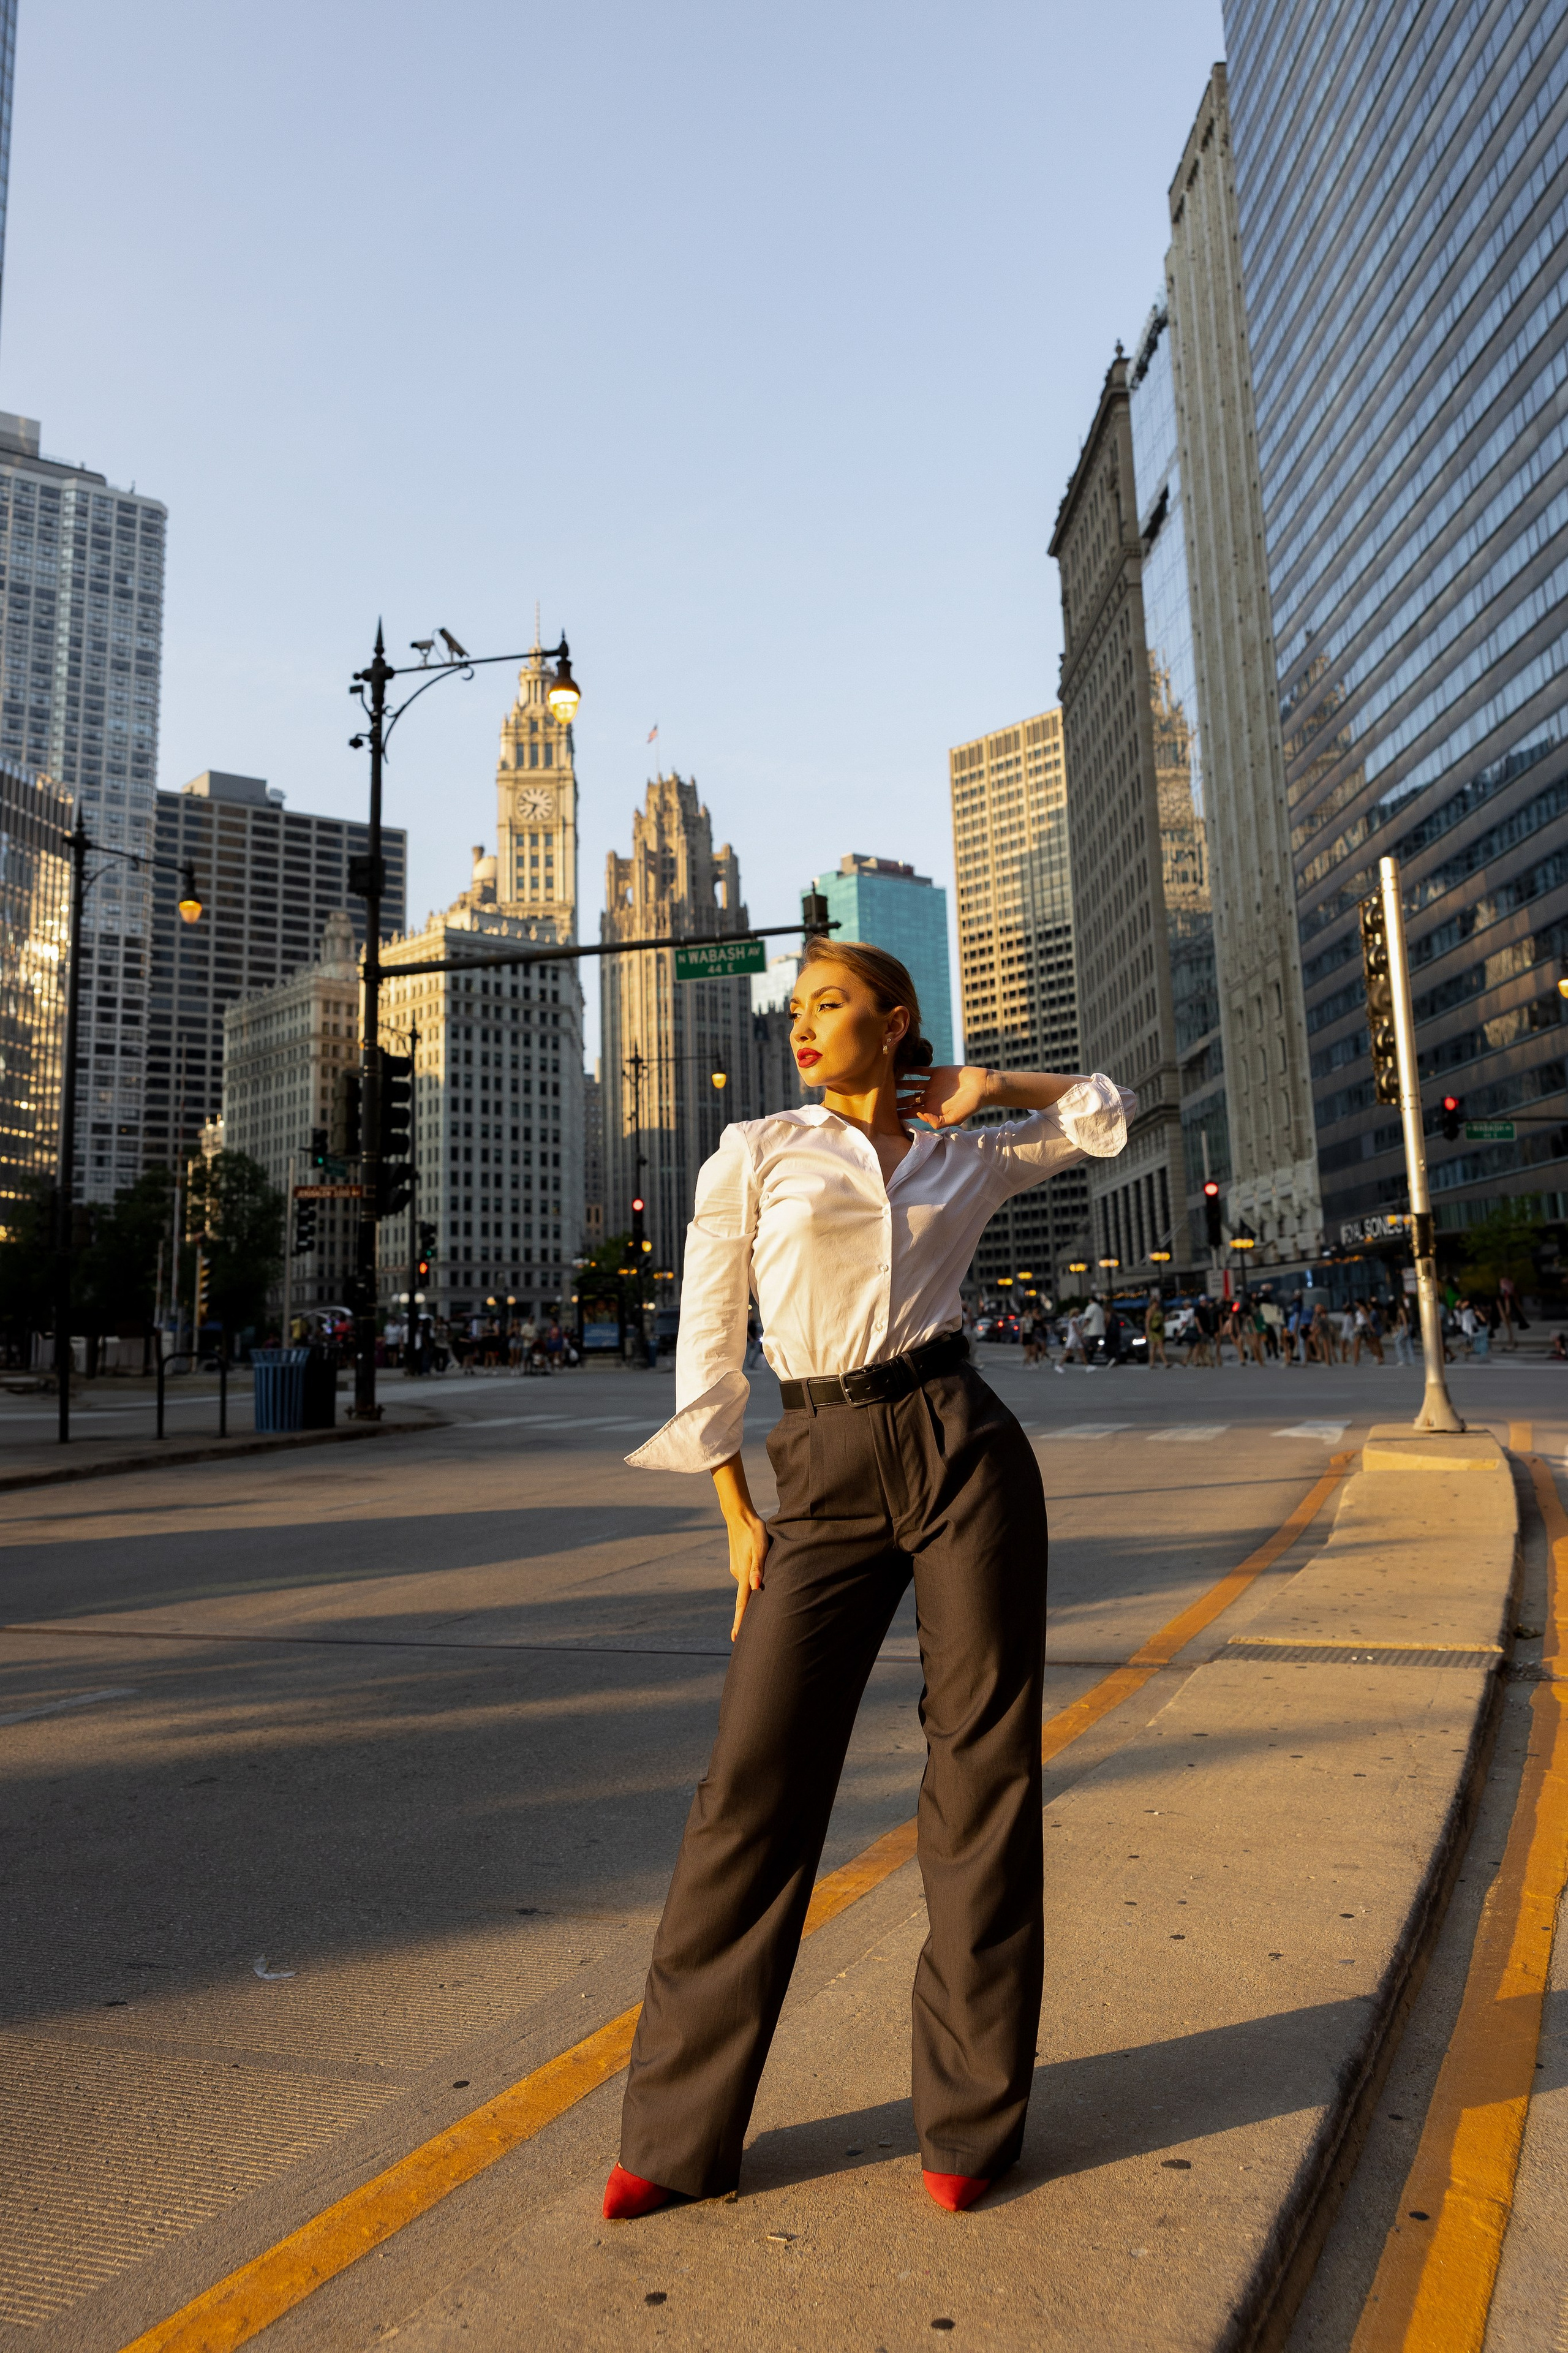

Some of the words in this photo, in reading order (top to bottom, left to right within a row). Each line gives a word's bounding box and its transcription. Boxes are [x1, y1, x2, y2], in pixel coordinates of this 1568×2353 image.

[678, 954, 686, 964] N
[688, 946, 745, 964] WABASH
[747, 946, 760, 957] AV
[707, 964, 722, 974] 44
[727, 962, 734, 973] E
